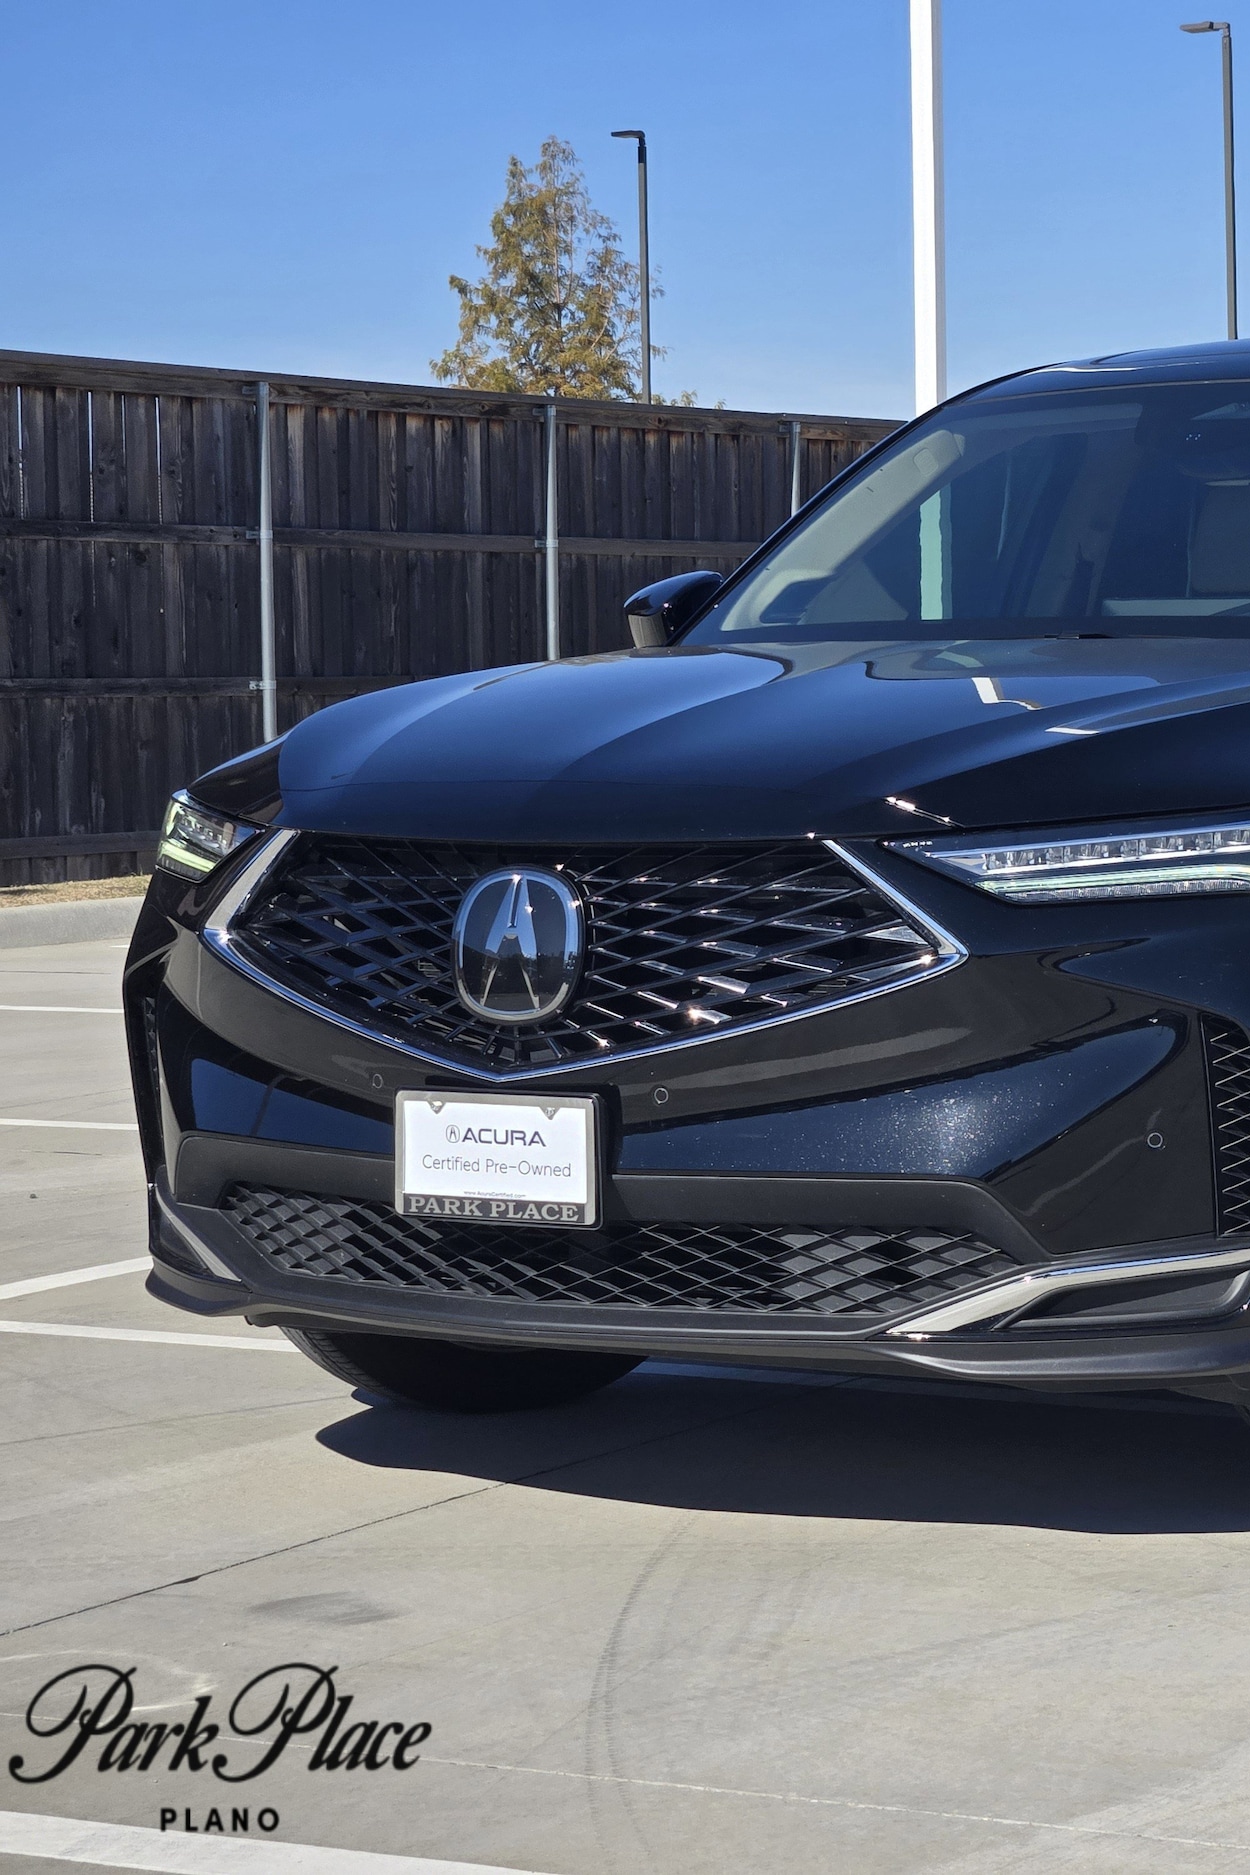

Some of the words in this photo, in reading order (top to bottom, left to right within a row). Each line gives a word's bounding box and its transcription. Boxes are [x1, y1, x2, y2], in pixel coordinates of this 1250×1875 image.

[461, 1127, 547, 1147] ACURA
[422, 1154, 480, 1173] Certified
[486, 1158, 572, 1177] Pre-Owned
[408, 1196, 484, 1217] PARK
[489, 1201, 579, 1222] PLACE
